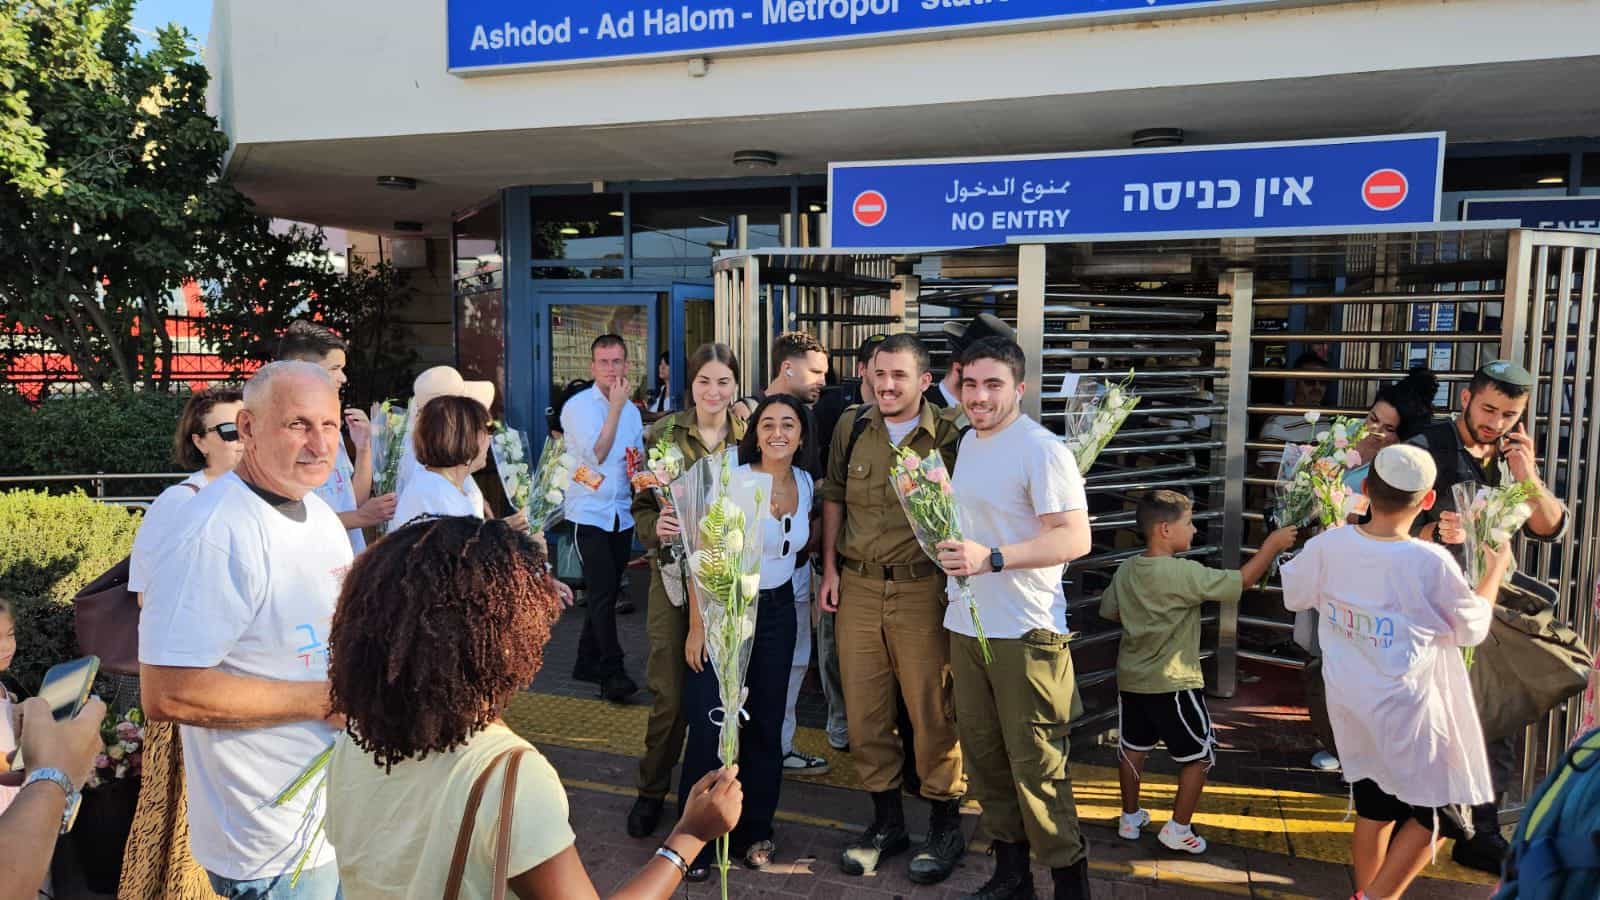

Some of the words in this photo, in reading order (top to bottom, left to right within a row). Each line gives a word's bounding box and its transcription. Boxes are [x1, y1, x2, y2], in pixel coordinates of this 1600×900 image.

[470, 17, 571, 50] Ashdod
[597, 12, 634, 40] Ad
[644, 6, 734, 36] Halom
[945, 177, 1015, 203] الدخول
[1021, 179, 1070, 204] ممنوع
[1123, 179, 1241, 212] כניסה
[1254, 176, 1314, 218] אין
[951, 211, 985, 231] NO
[992, 209, 1070, 229] ENTRY
